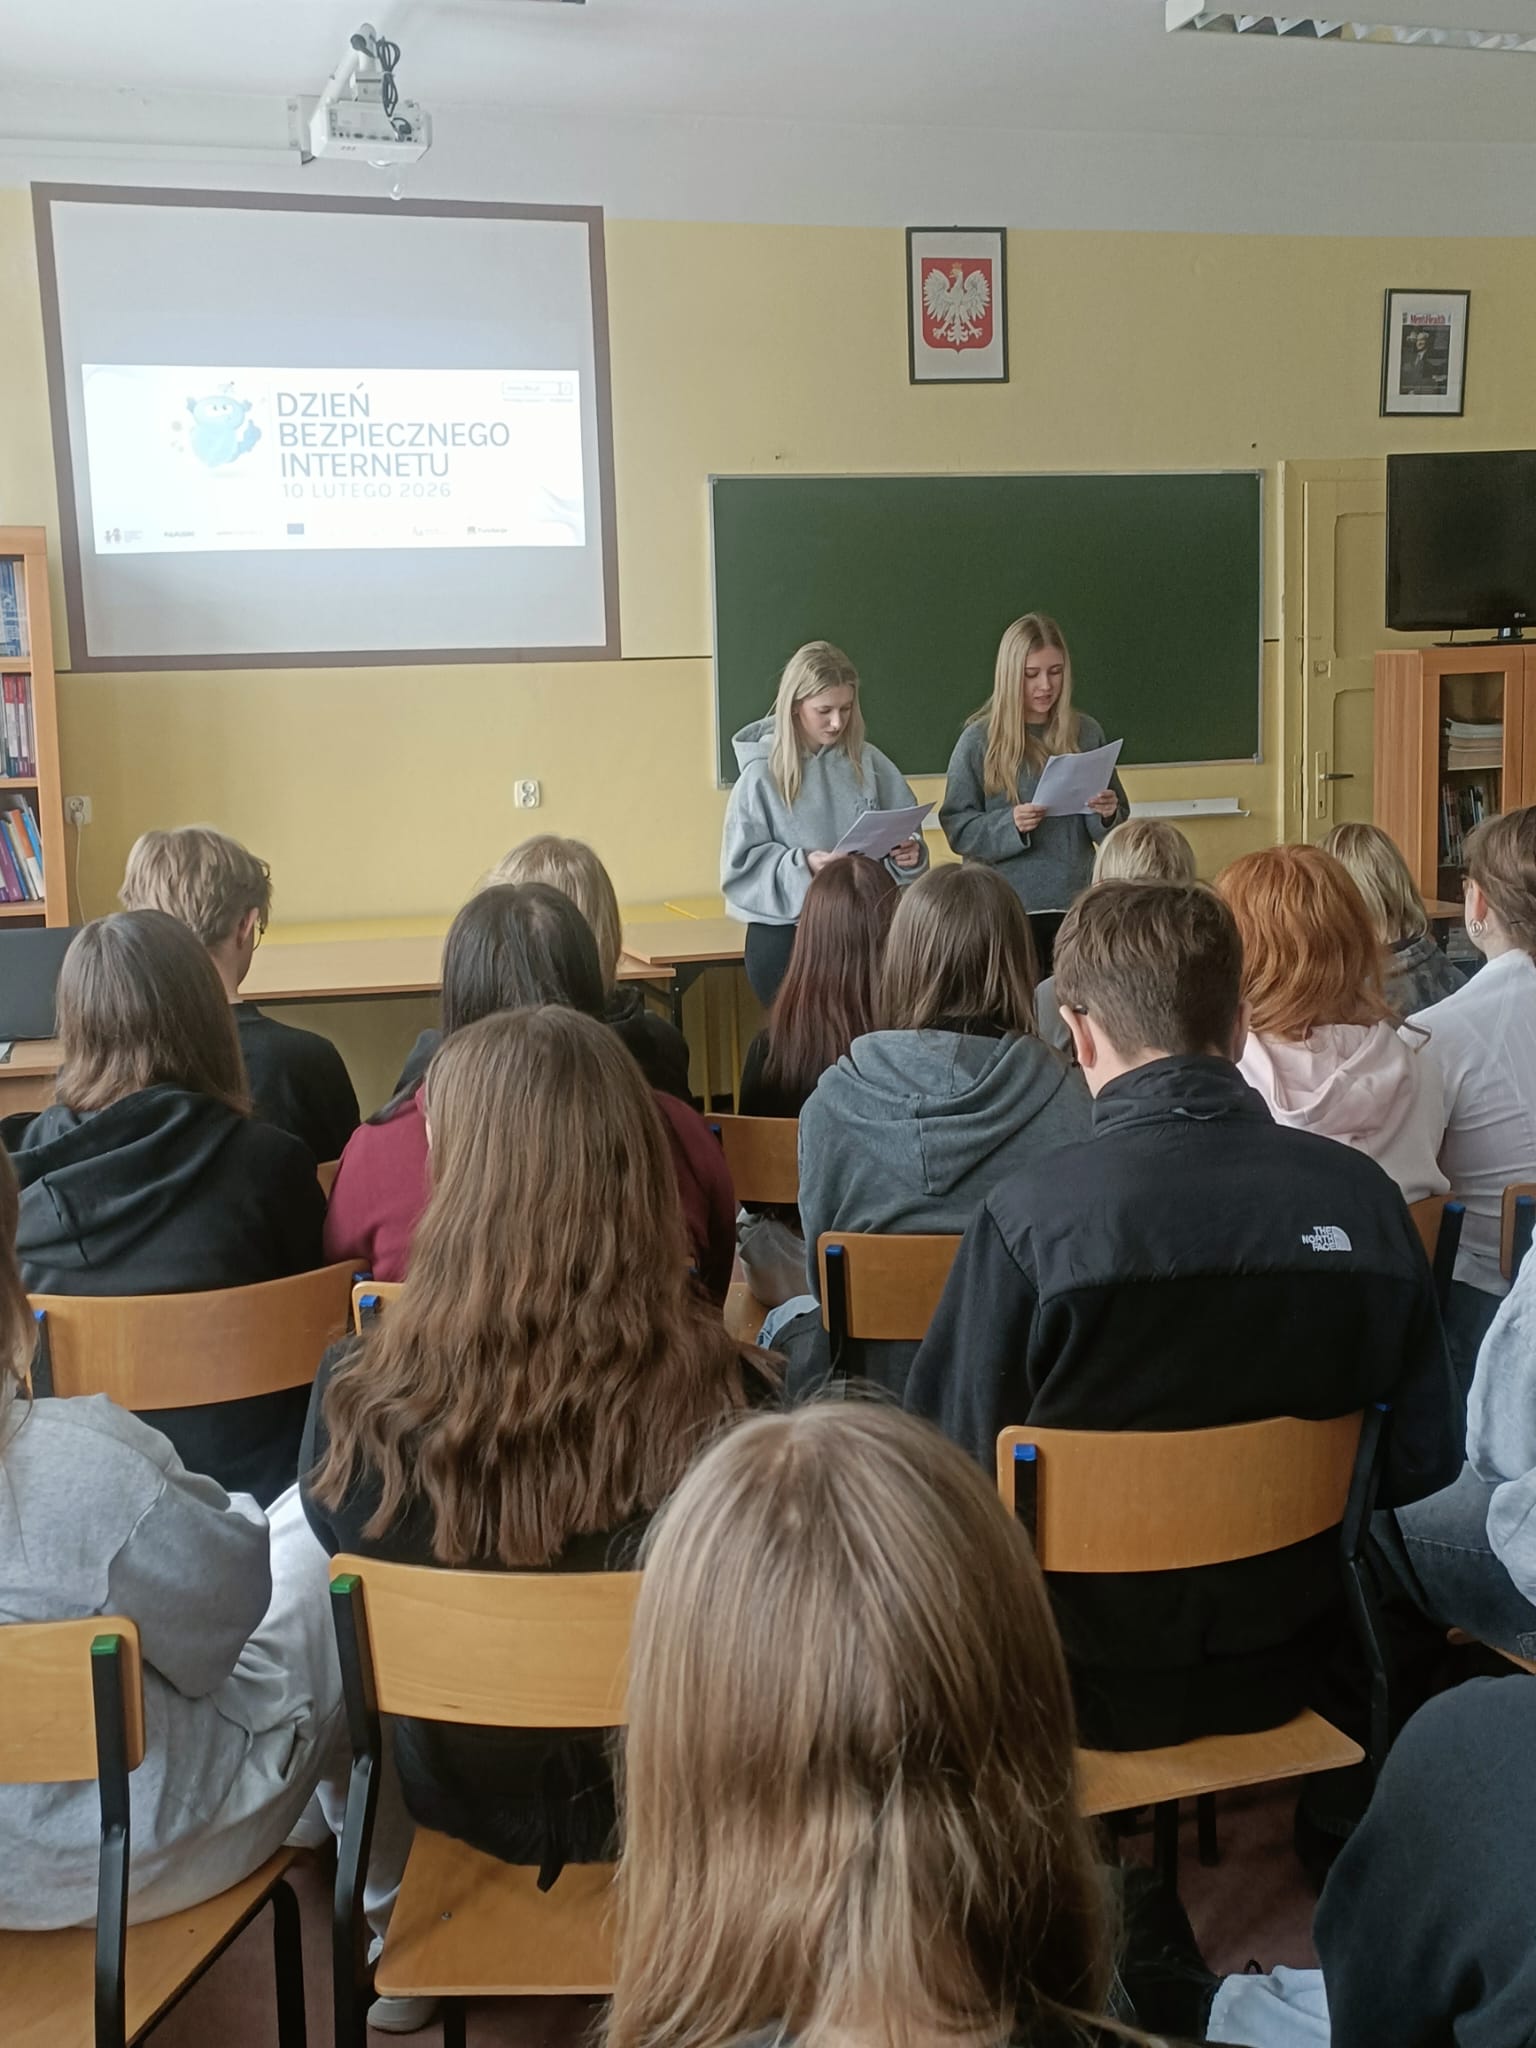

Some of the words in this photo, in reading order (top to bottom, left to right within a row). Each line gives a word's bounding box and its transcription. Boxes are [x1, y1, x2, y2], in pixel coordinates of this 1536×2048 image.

[277, 382, 370, 417] DZIEŃ
[279, 422, 510, 447] BEZPIECZNEGO
[281, 452, 449, 478] INTERNETU
[282, 482, 304, 498] 10
[312, 482, 392, 498] LUTEGO
[400, 482, 452, 498] 2026
[1313, 1226, 1333, 1235] THE
[1302, 1234, 1334, 1244] NORTH
[1312, 1243, 1336, 1251] FACE
